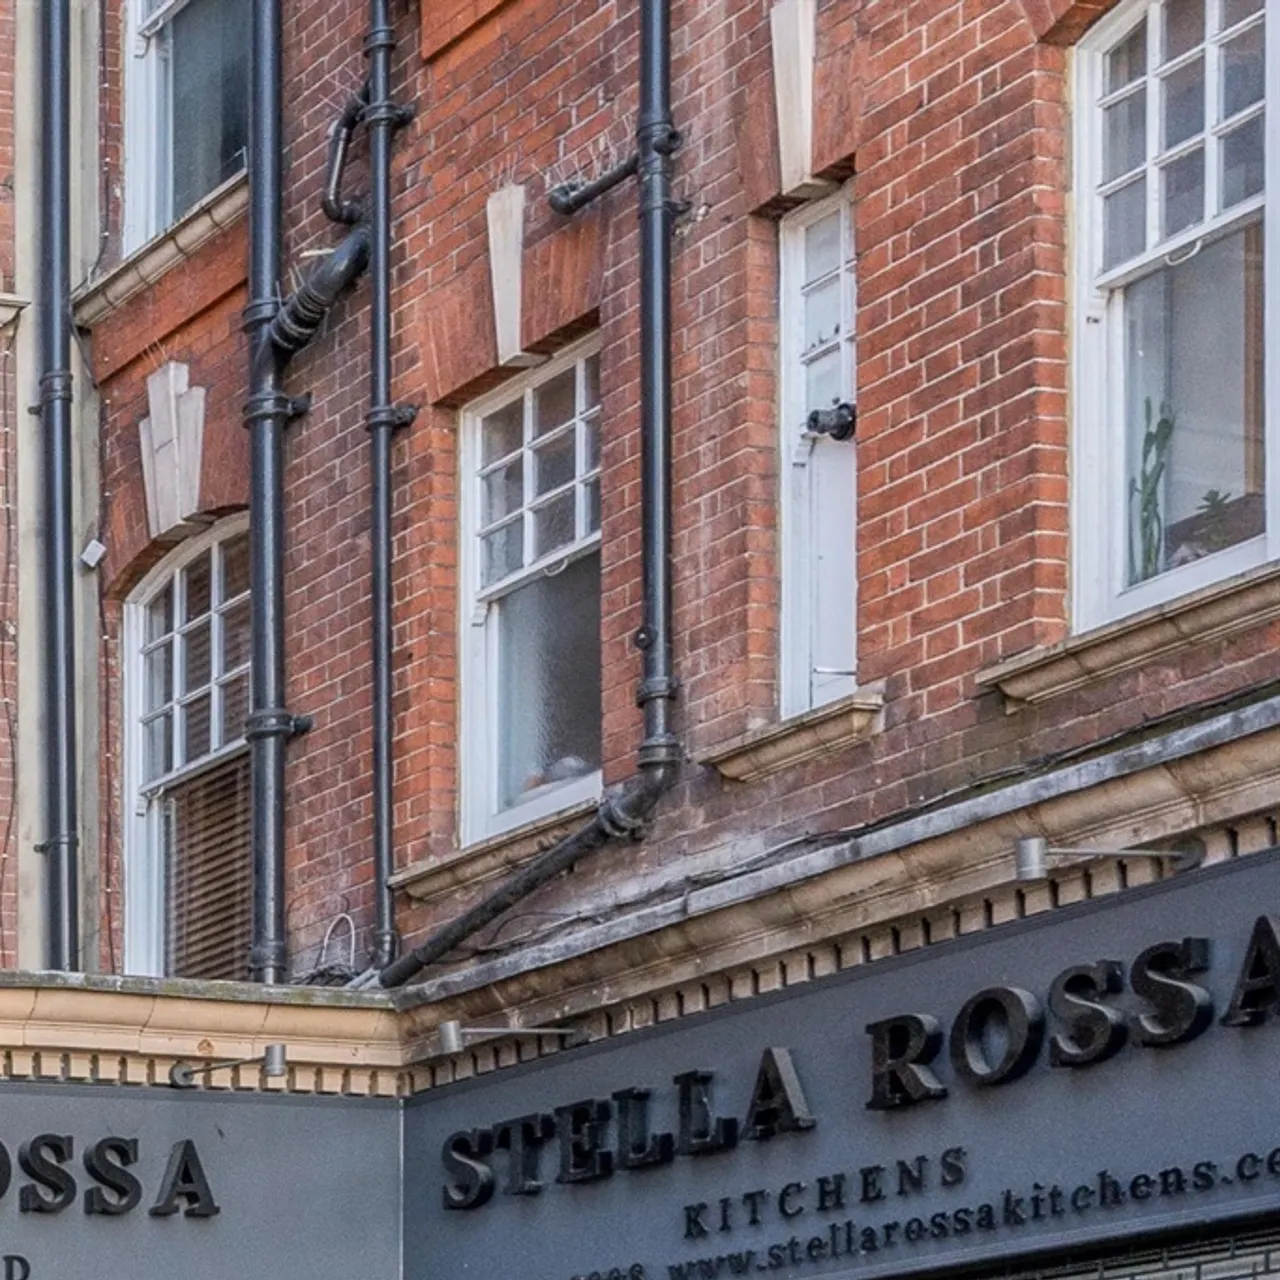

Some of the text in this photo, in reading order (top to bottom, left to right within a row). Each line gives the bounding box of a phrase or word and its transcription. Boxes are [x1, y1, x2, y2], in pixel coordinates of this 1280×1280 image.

[442, 915, 1280, 1210] STELLA ROSSA
[683, 1146, 968, 1239] KITCHENS
